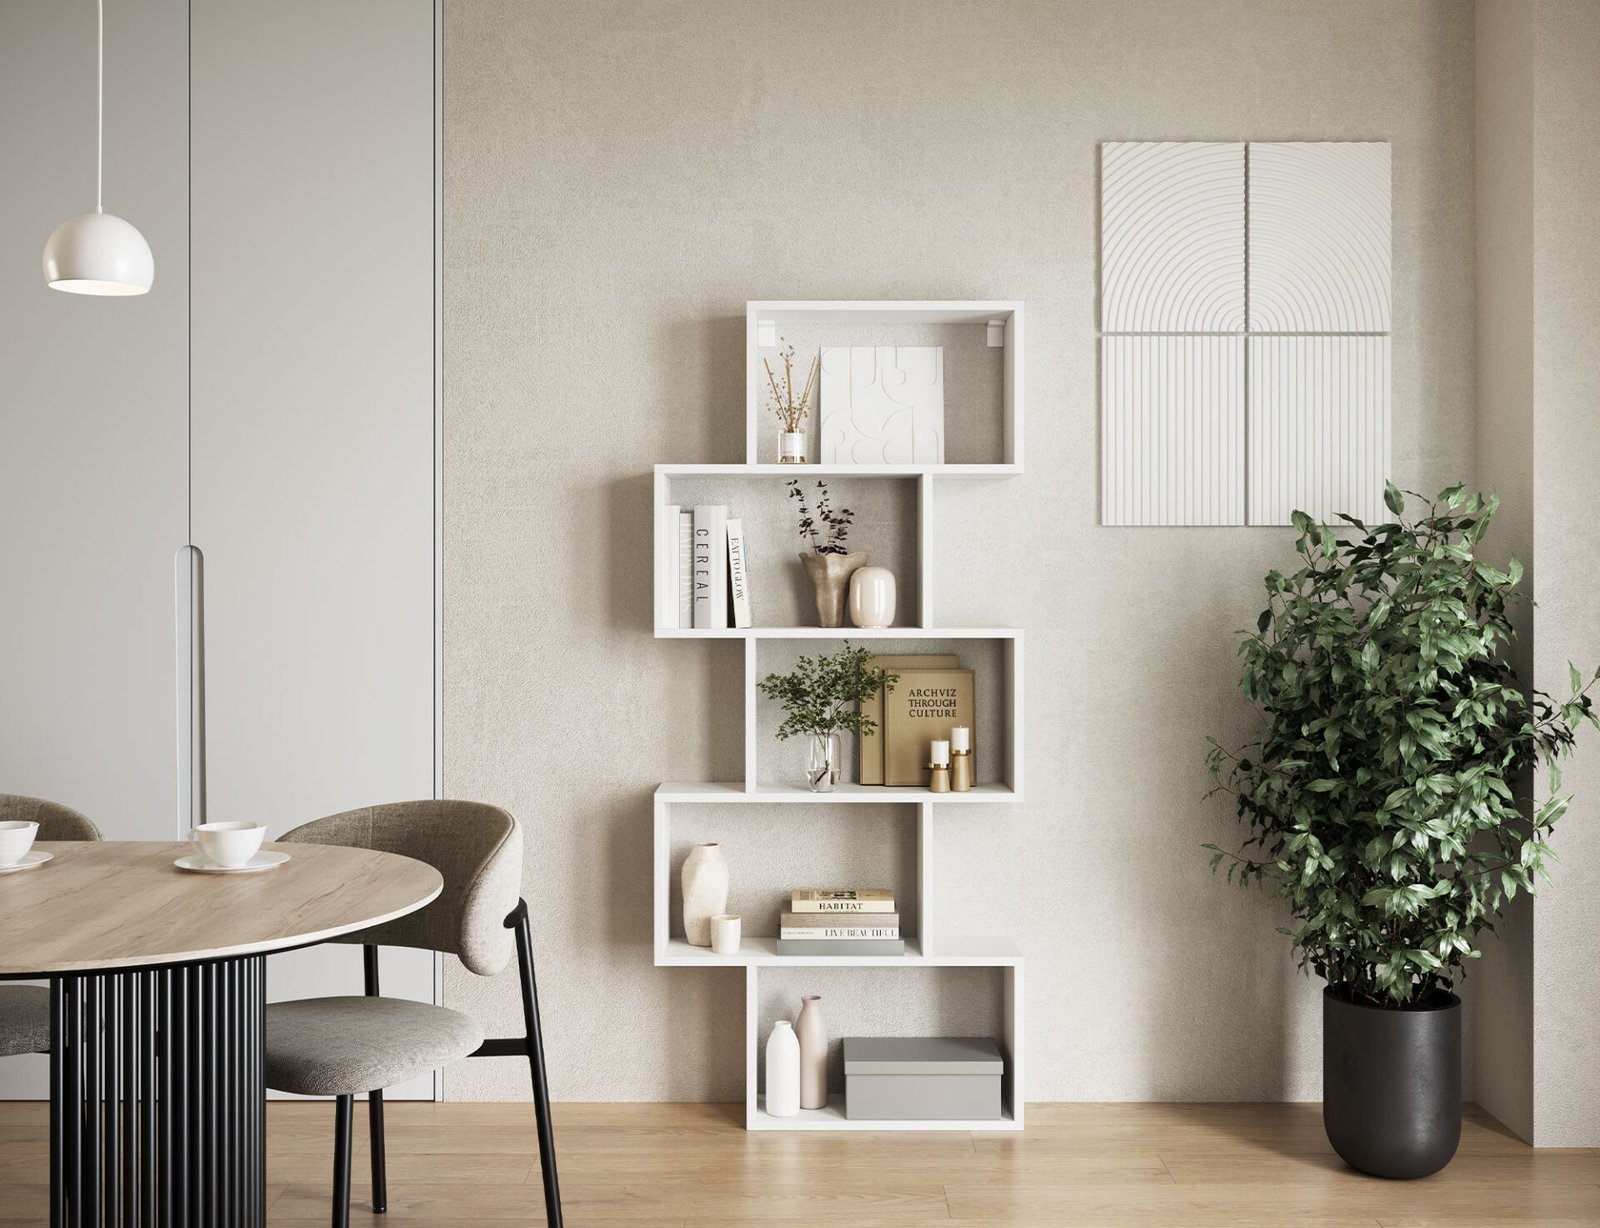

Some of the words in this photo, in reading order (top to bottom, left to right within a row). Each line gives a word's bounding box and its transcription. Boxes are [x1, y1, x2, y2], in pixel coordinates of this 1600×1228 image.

[731, 537, 740, 556] EAT
[696, 528, 709, 602] CEREAL
[733, 557, 741, 570] TO
[734, 571, 744, 600] GLOW
[908, 688, 957, 697] ARCHVIZ
[908, 699, 957, 708] THROUGH
[908, 709, 957, 718] CULTURE
[825, 929, 845, 937] LIVE
[847, 929, 897, 937] BEAUTIFUL
